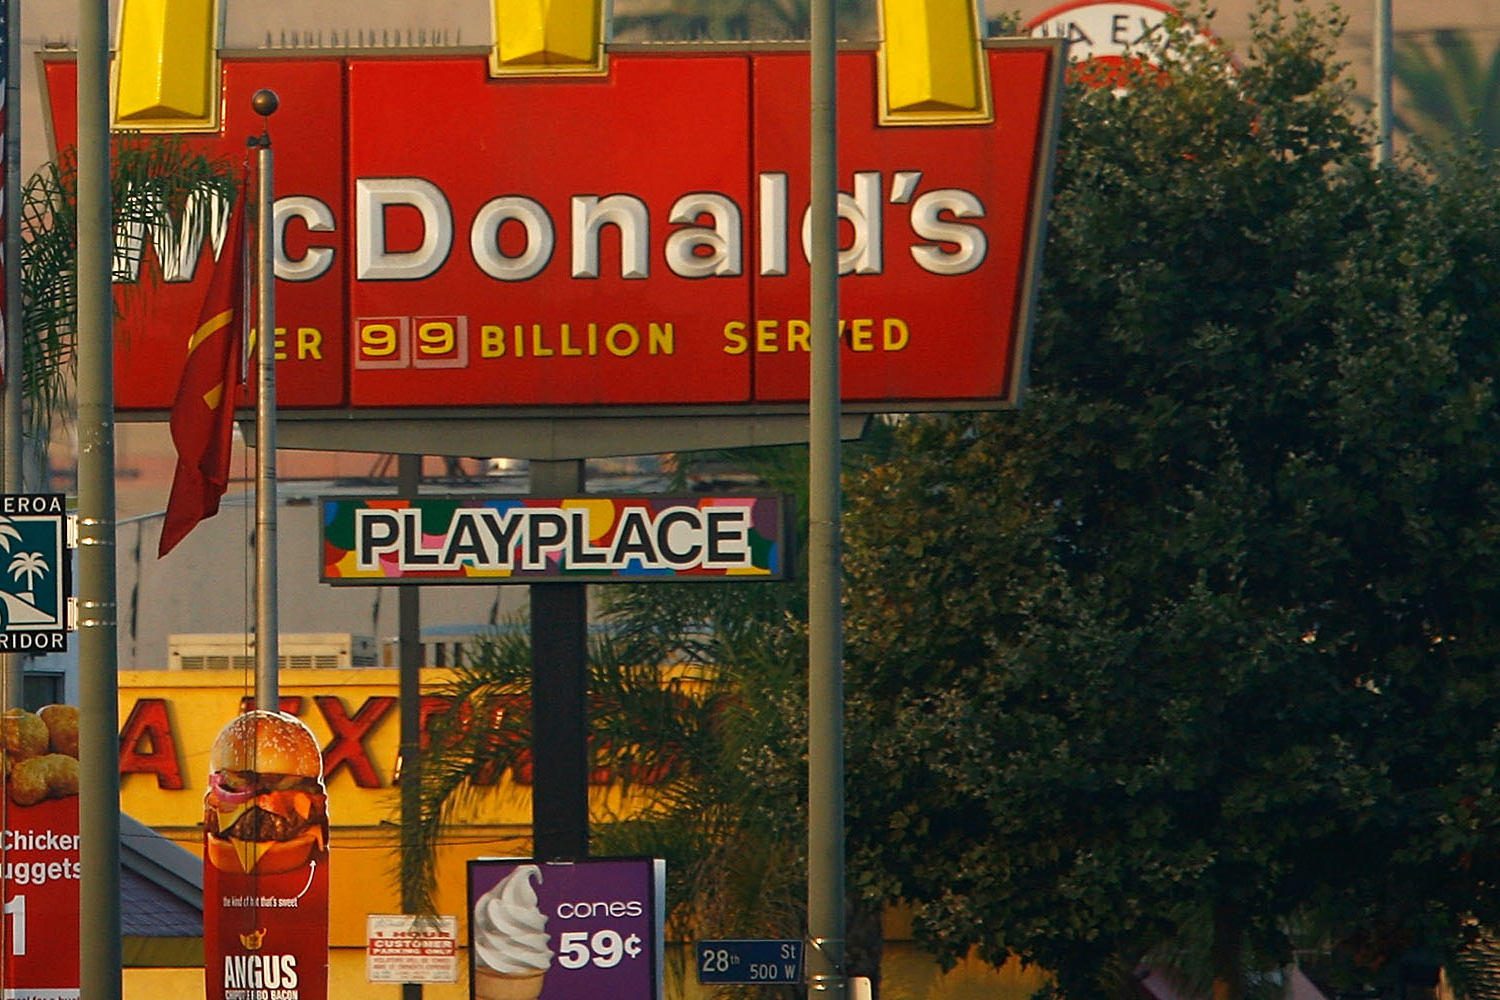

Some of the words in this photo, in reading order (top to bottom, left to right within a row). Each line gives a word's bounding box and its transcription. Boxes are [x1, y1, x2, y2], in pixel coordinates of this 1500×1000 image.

[361, 322, 454, 355] 99
[481, 324, 674, 358] BILLION
[724, 318, 909, 355] SERED
[355, 506, 752, 571] PLAYPLACE
[278, 897, 298, 907] sweet
[557, 901, 642, 919] cones
[374, 940, 453, 948] CUSTOMER
[558, 929, 642, 969] 59¢
[702, 948, 740, 972] 28th
[781, 943, 796, 959] St
[225, 954, 298, 989] ANGUS
[750, 963, 778, 979] 500
[784, 964, 796, 979] W
